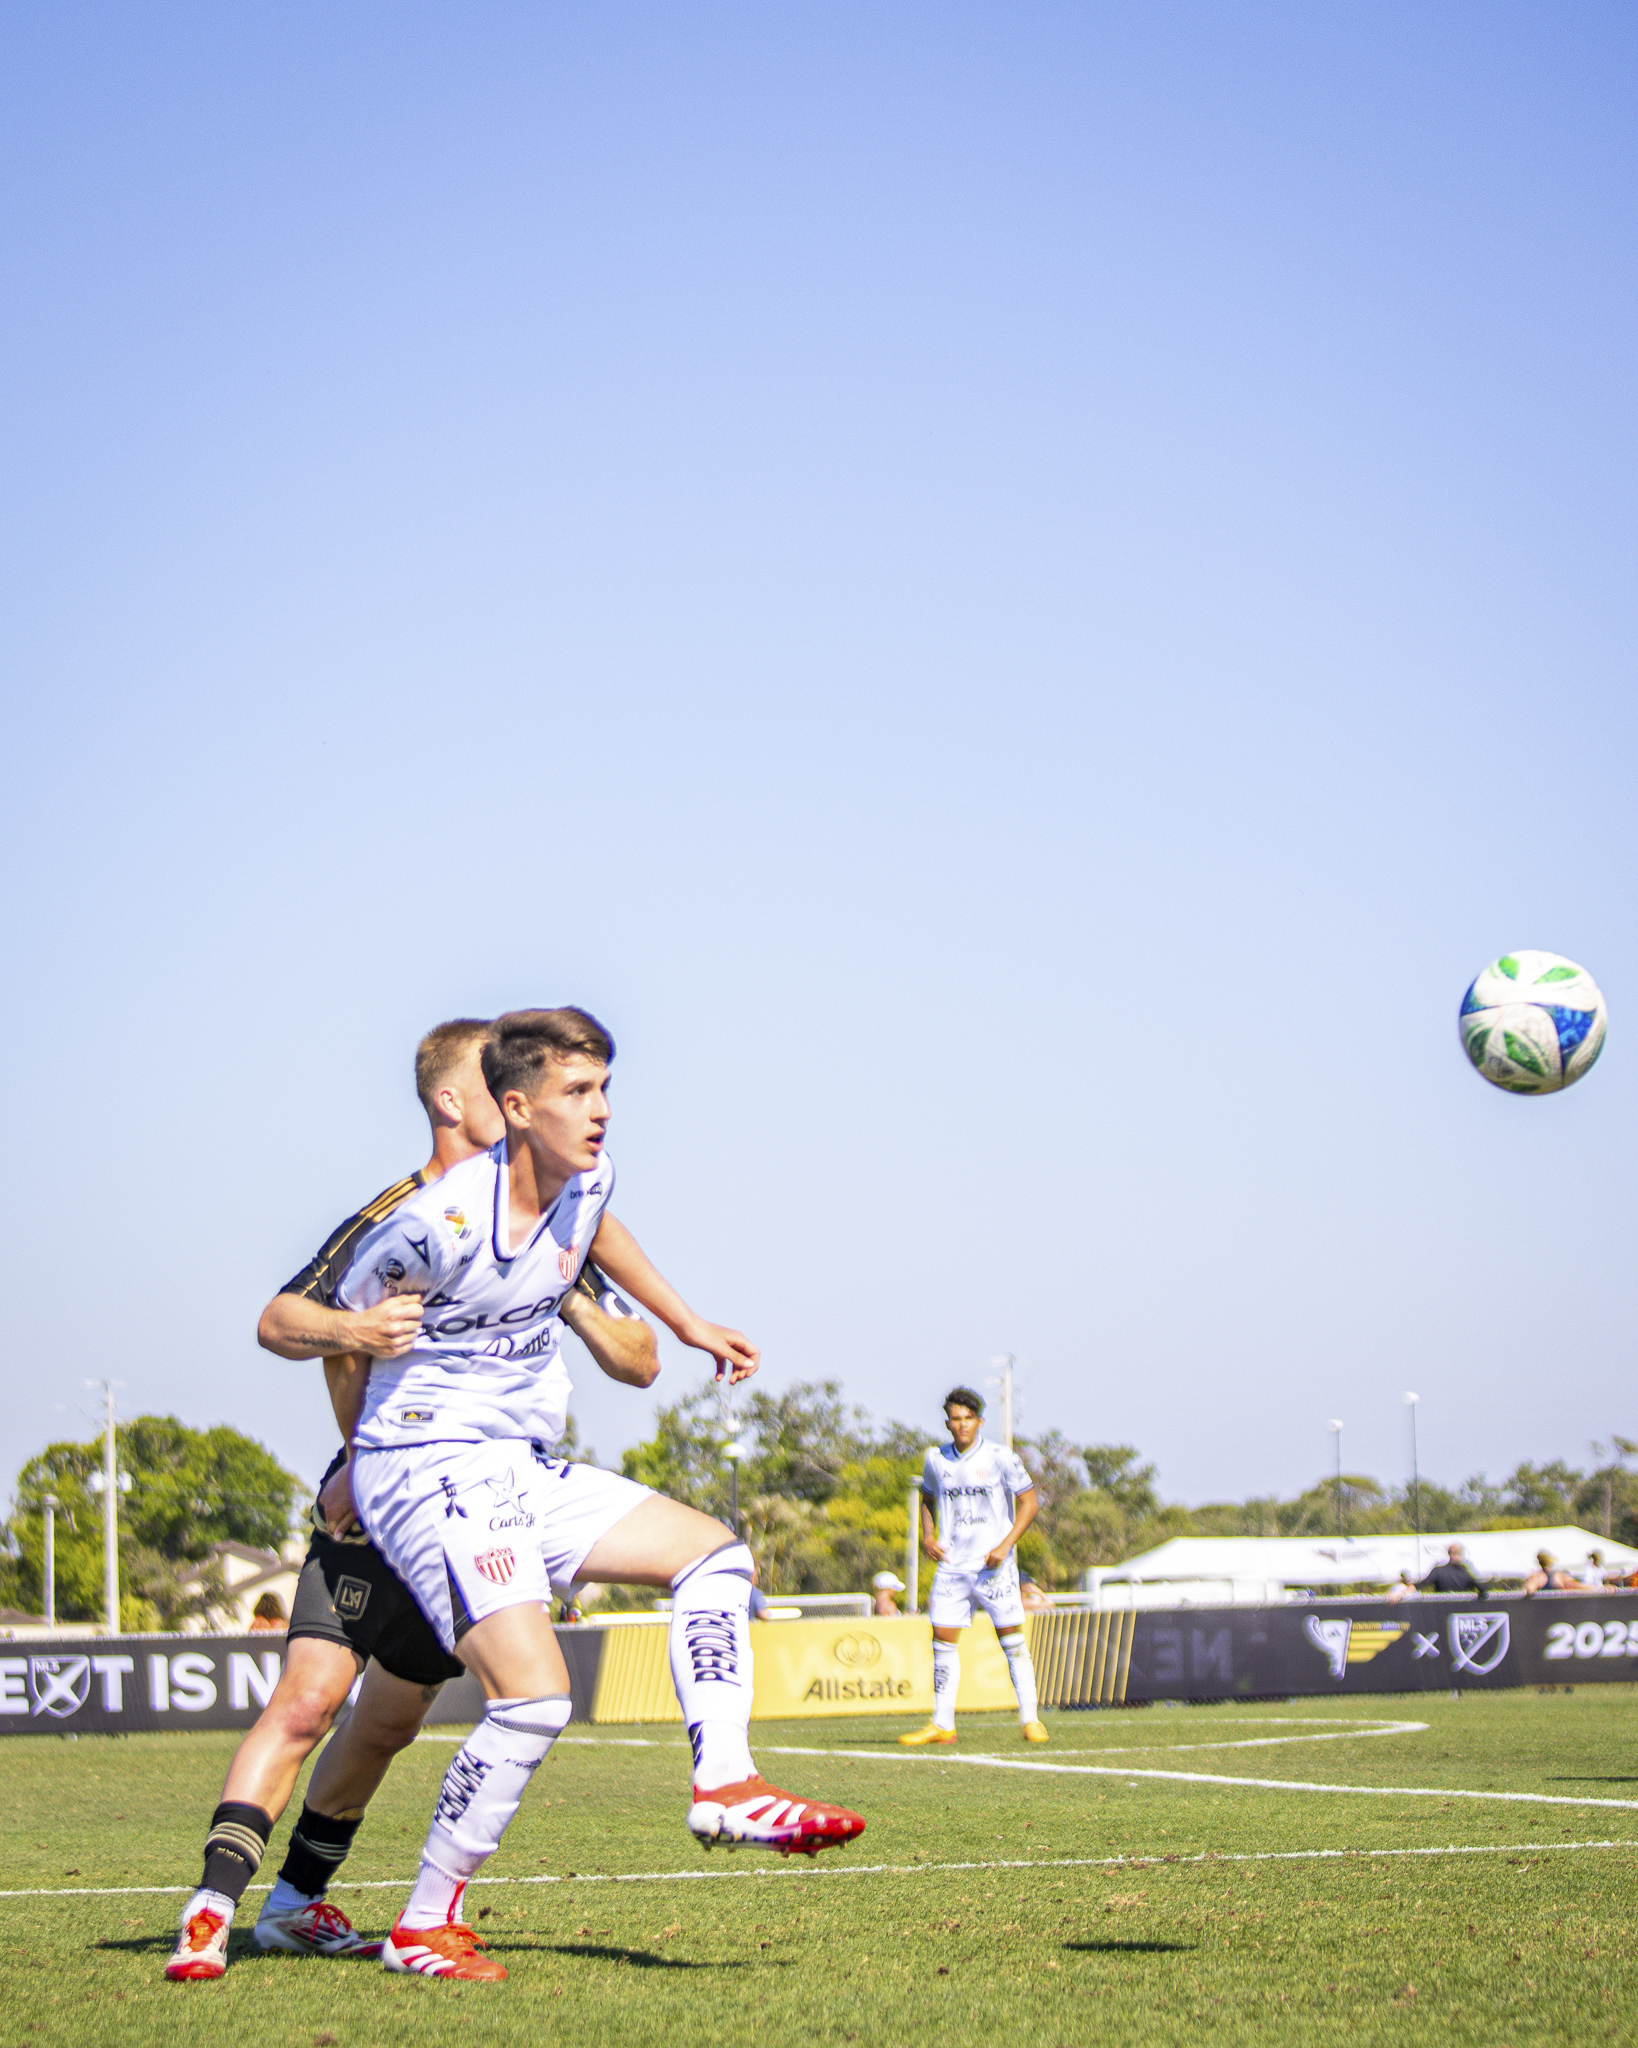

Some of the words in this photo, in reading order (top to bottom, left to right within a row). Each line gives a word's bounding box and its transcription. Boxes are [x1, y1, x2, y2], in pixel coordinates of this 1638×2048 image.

[1459, 1617, 1488, 1634] MLS
[150, 1651, 218, 1712] IS
[803, 1676, 913, 1702] Allstate
